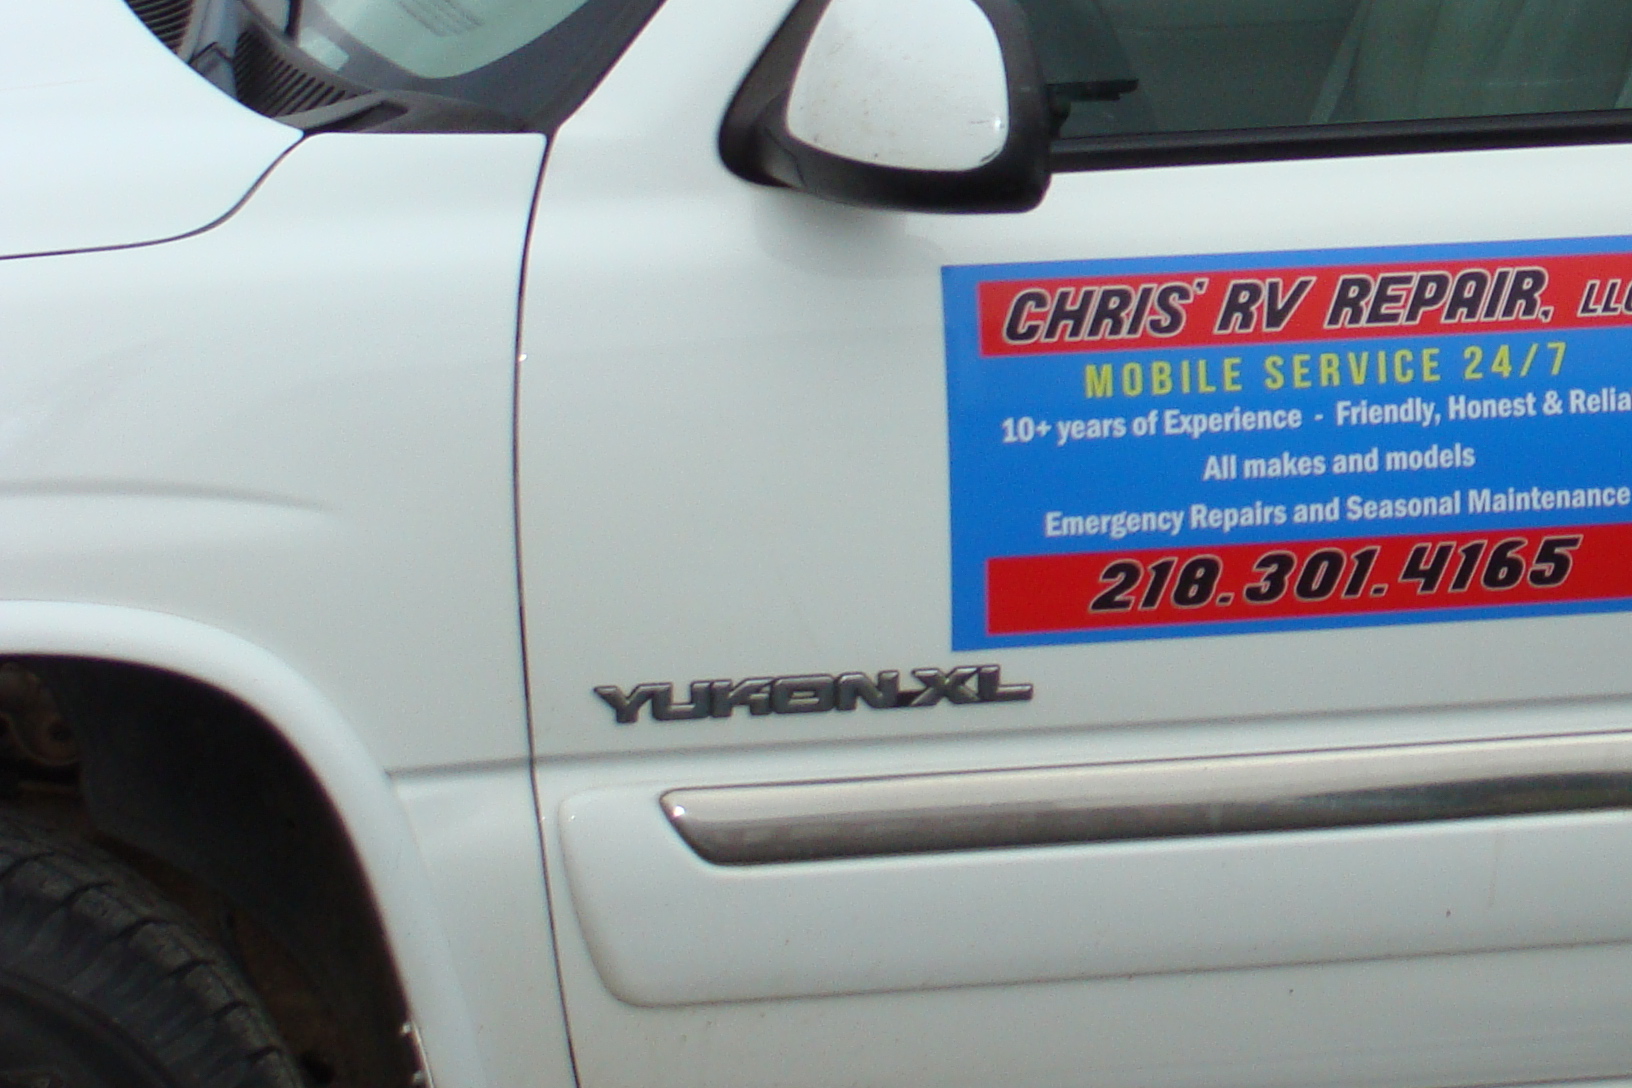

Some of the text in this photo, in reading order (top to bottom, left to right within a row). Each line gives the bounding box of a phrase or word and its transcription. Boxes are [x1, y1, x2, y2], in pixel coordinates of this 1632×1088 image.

[1003, 278, 1209, 344] CHRIS'
[1213, 276, 1317, 334] RV
[1323, 267, 1553, 329] REPAIR,
[1085, 341, 1567, 398] MOBILE SERVICE 24/7
[1002, 416, 1051, 443] 10+
[1057, 414, 1126, 447] years
[1132, 410, 1158, 436] of
[1164, 406, 1302, 439] Experience
[1336, 397, 1441, 427] Friendly,
[1448, 391, 1536, 420] Honest
[1543, 390, 1563, 414] &
[1203, 443, 1476, 480] All makes and models
[1045, 485, 1631, 539] Emergency Repairs and Seasonal Maintenance
[1088, 534, 1584, 613] 218.301.4165
[594, 664, 1034, 723] YUKON XL
